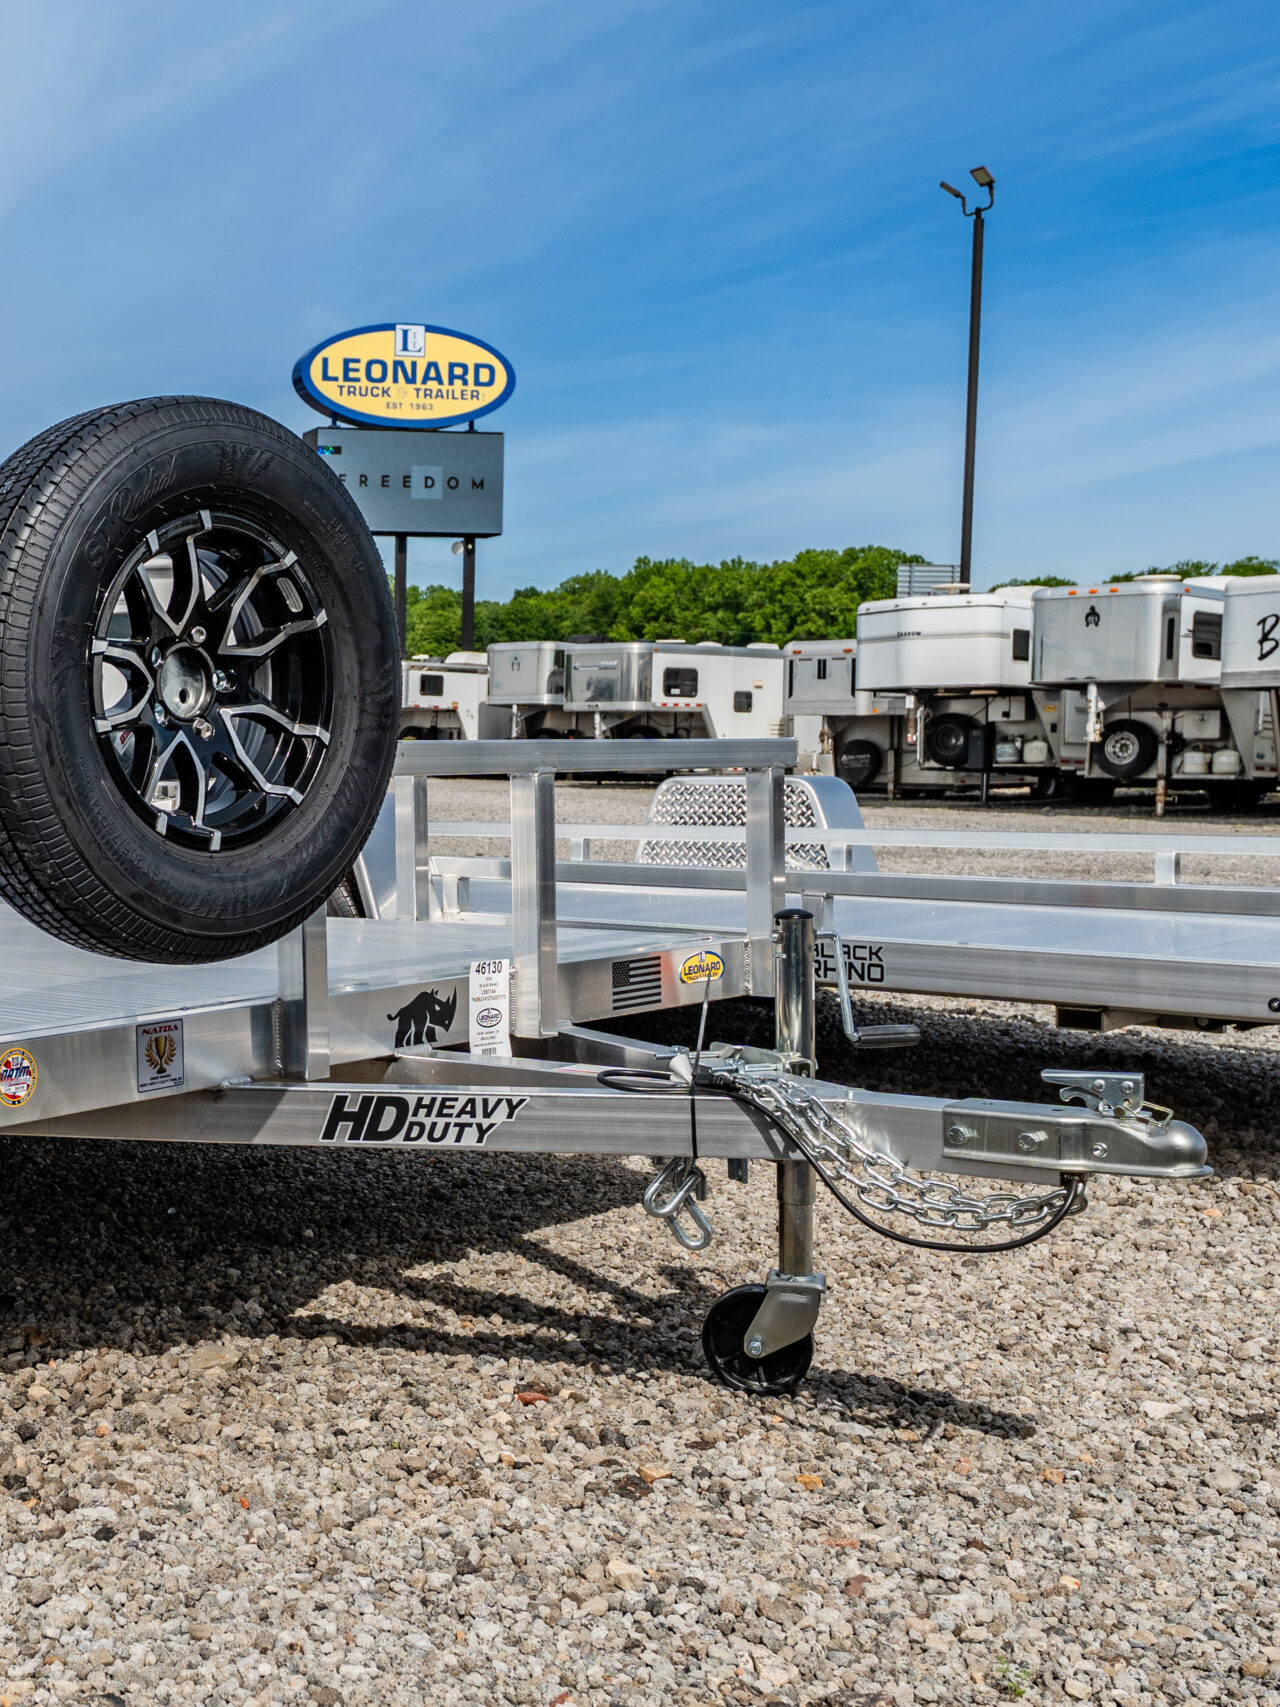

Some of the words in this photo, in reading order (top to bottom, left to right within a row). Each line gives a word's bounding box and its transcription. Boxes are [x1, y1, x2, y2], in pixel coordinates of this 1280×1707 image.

[321, 357, 496, 387] LEONARD
[337, 385, 391, 398] TRUCK
[414, 387, 480, 400] TRAILER
[410, 403, 434, 411] 1963
[338, 474, 485, 490] FREEDOM
[109, 455, 177, 525] Radial
[475, 961, 503, 975] 46130
[684, 961, 721, 976] LEONARD
[142, 1024, 180, 1037] NATDA
[321, 1095, 410, 1141] HD
[411, 1096, 529, 1120] HEAVY
[402, 1121, 498, 1144] DUTY
